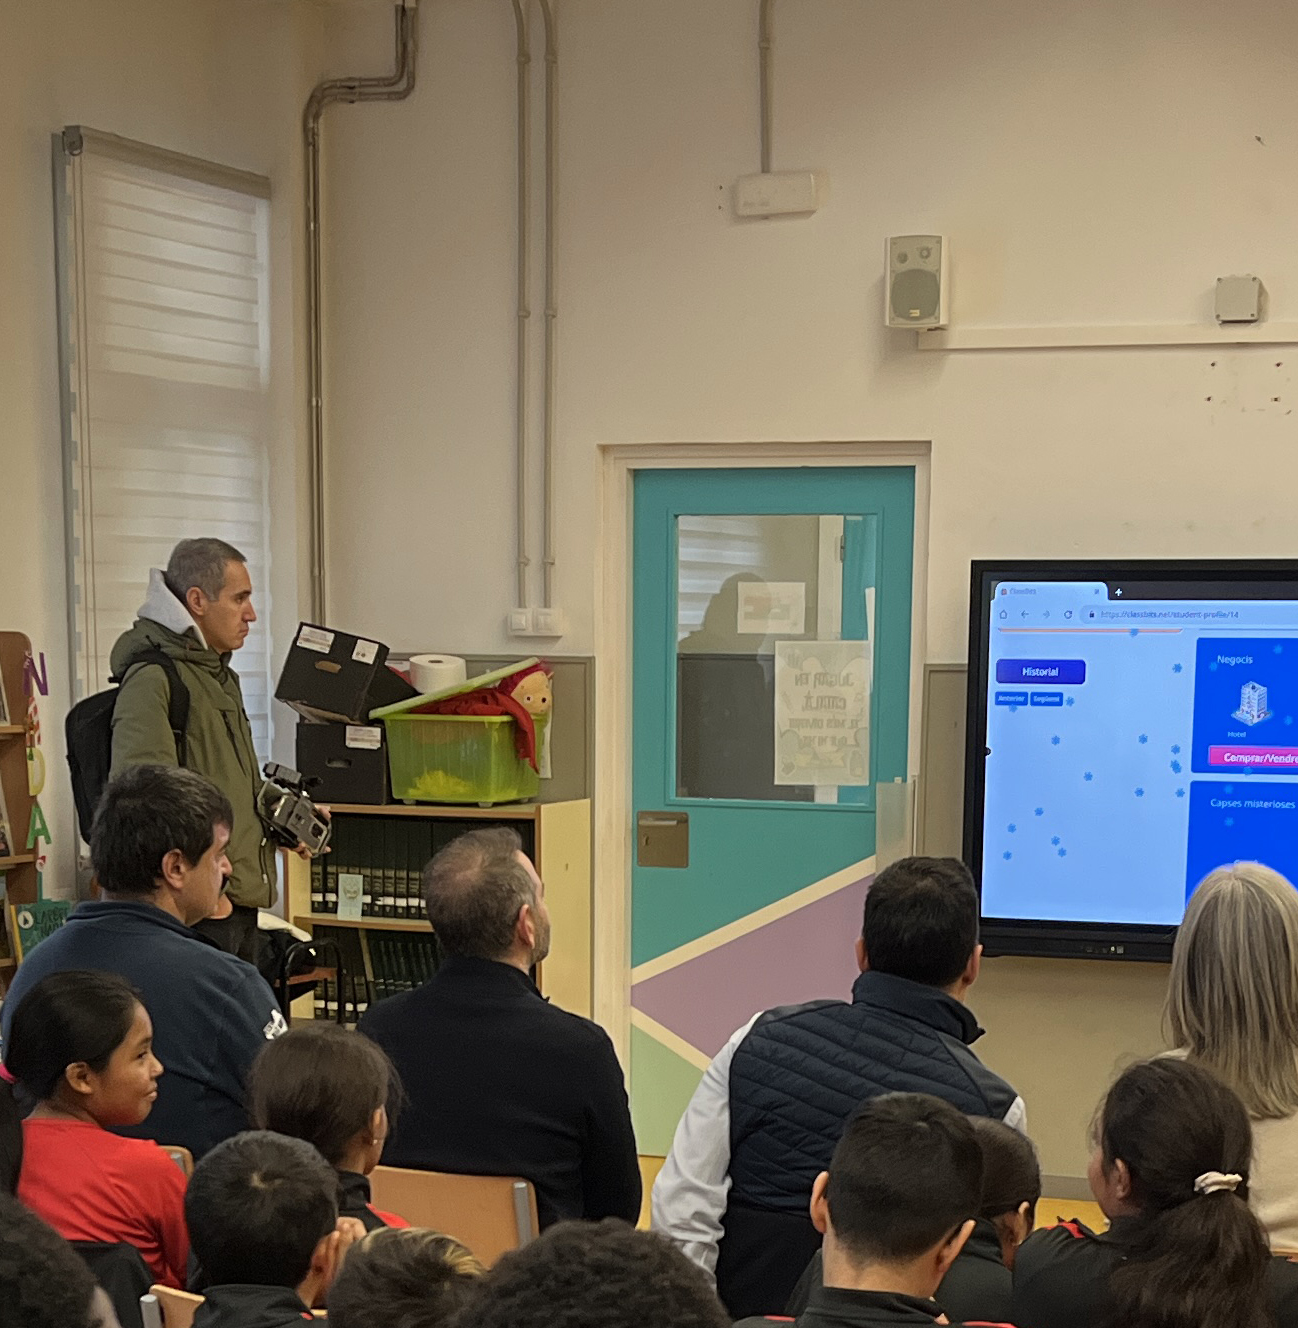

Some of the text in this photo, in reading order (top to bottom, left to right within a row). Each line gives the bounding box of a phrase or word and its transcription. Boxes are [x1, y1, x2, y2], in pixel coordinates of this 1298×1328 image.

[1217, 655, 1253, 667] Negocis
[1022, 667, 1059, 677] Historial
[1210, 799, 1296, 809] Capses misterioses
